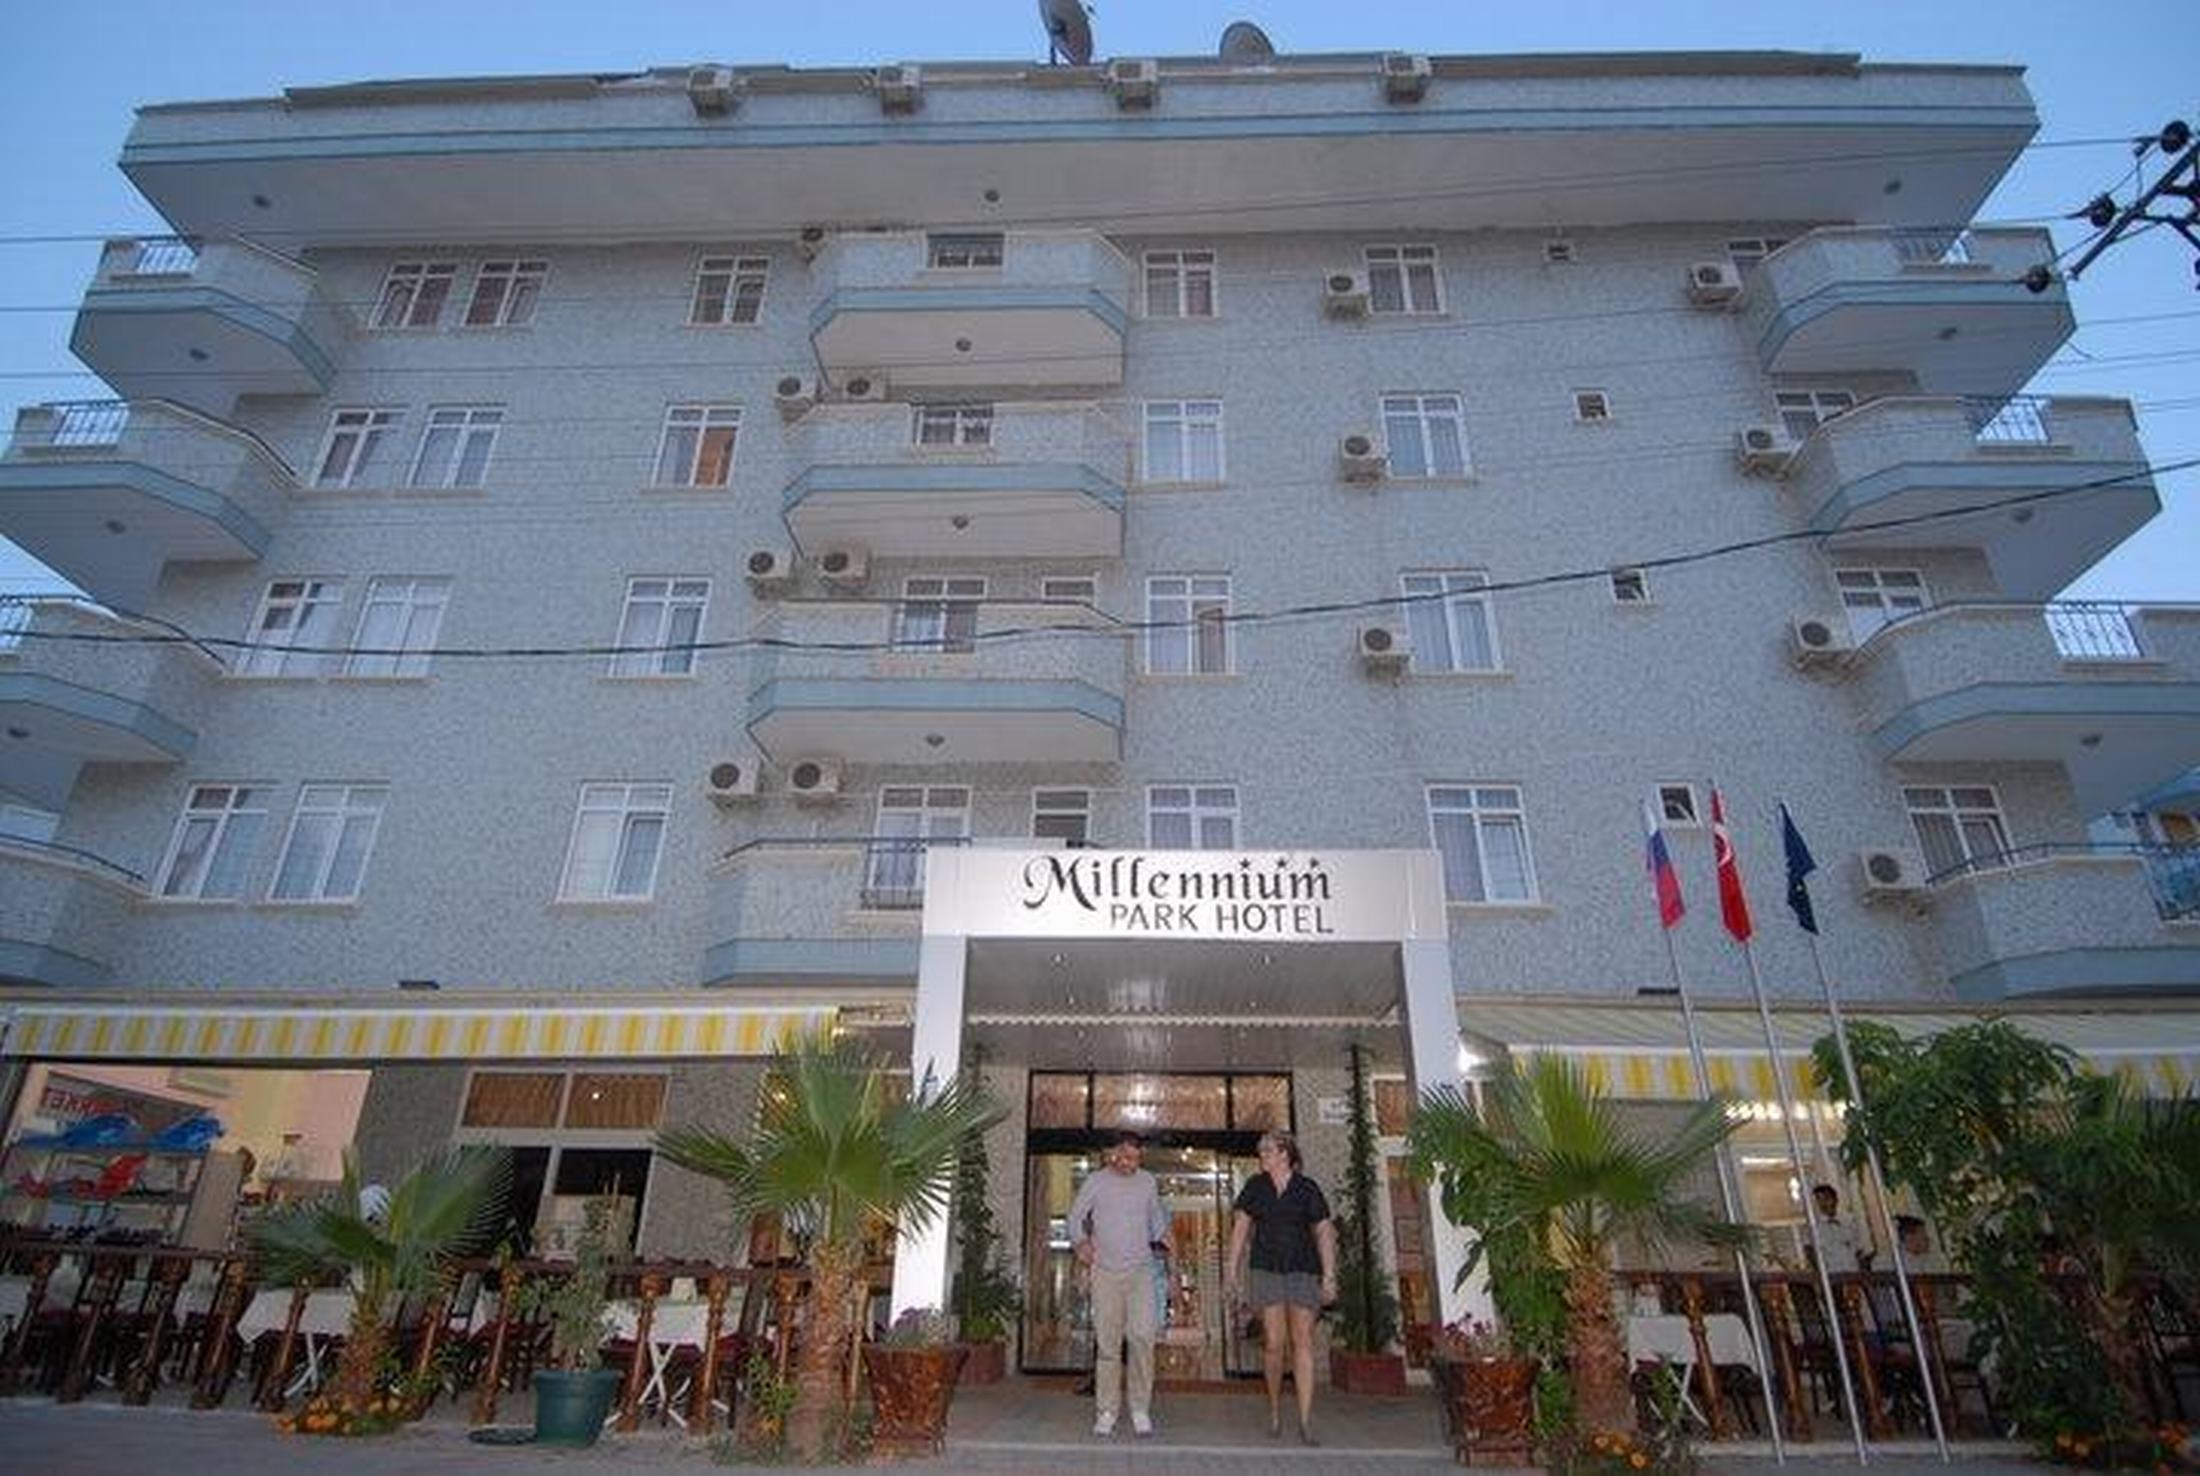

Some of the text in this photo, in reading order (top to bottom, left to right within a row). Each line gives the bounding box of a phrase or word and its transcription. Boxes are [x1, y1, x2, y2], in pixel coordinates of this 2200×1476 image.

[1023, 855, 1330, 911] Millennium
[1110, 903, 1334, 934] PARK HOTEL
